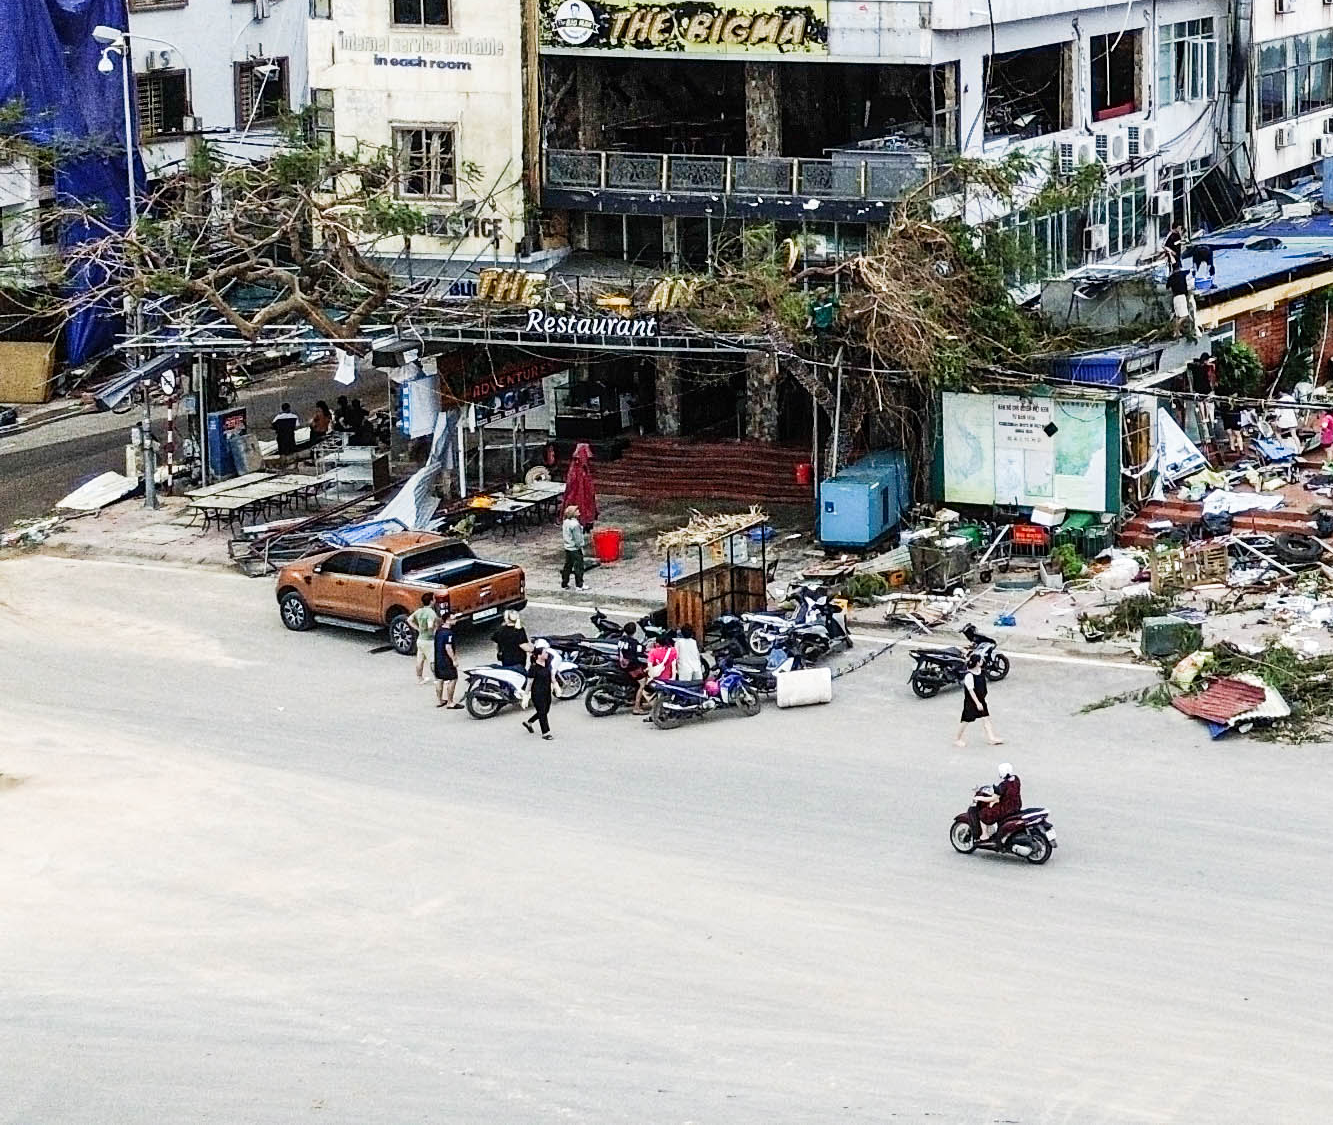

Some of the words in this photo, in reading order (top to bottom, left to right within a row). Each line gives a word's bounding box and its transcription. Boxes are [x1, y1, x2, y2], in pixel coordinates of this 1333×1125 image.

[609, 8, 673, 46] THE
[373, 54, 388, 66] in
[390, 56, 427, 68] each
[430, 60, 472, 71] room
[526, 308, 658, 338] Restaurant
